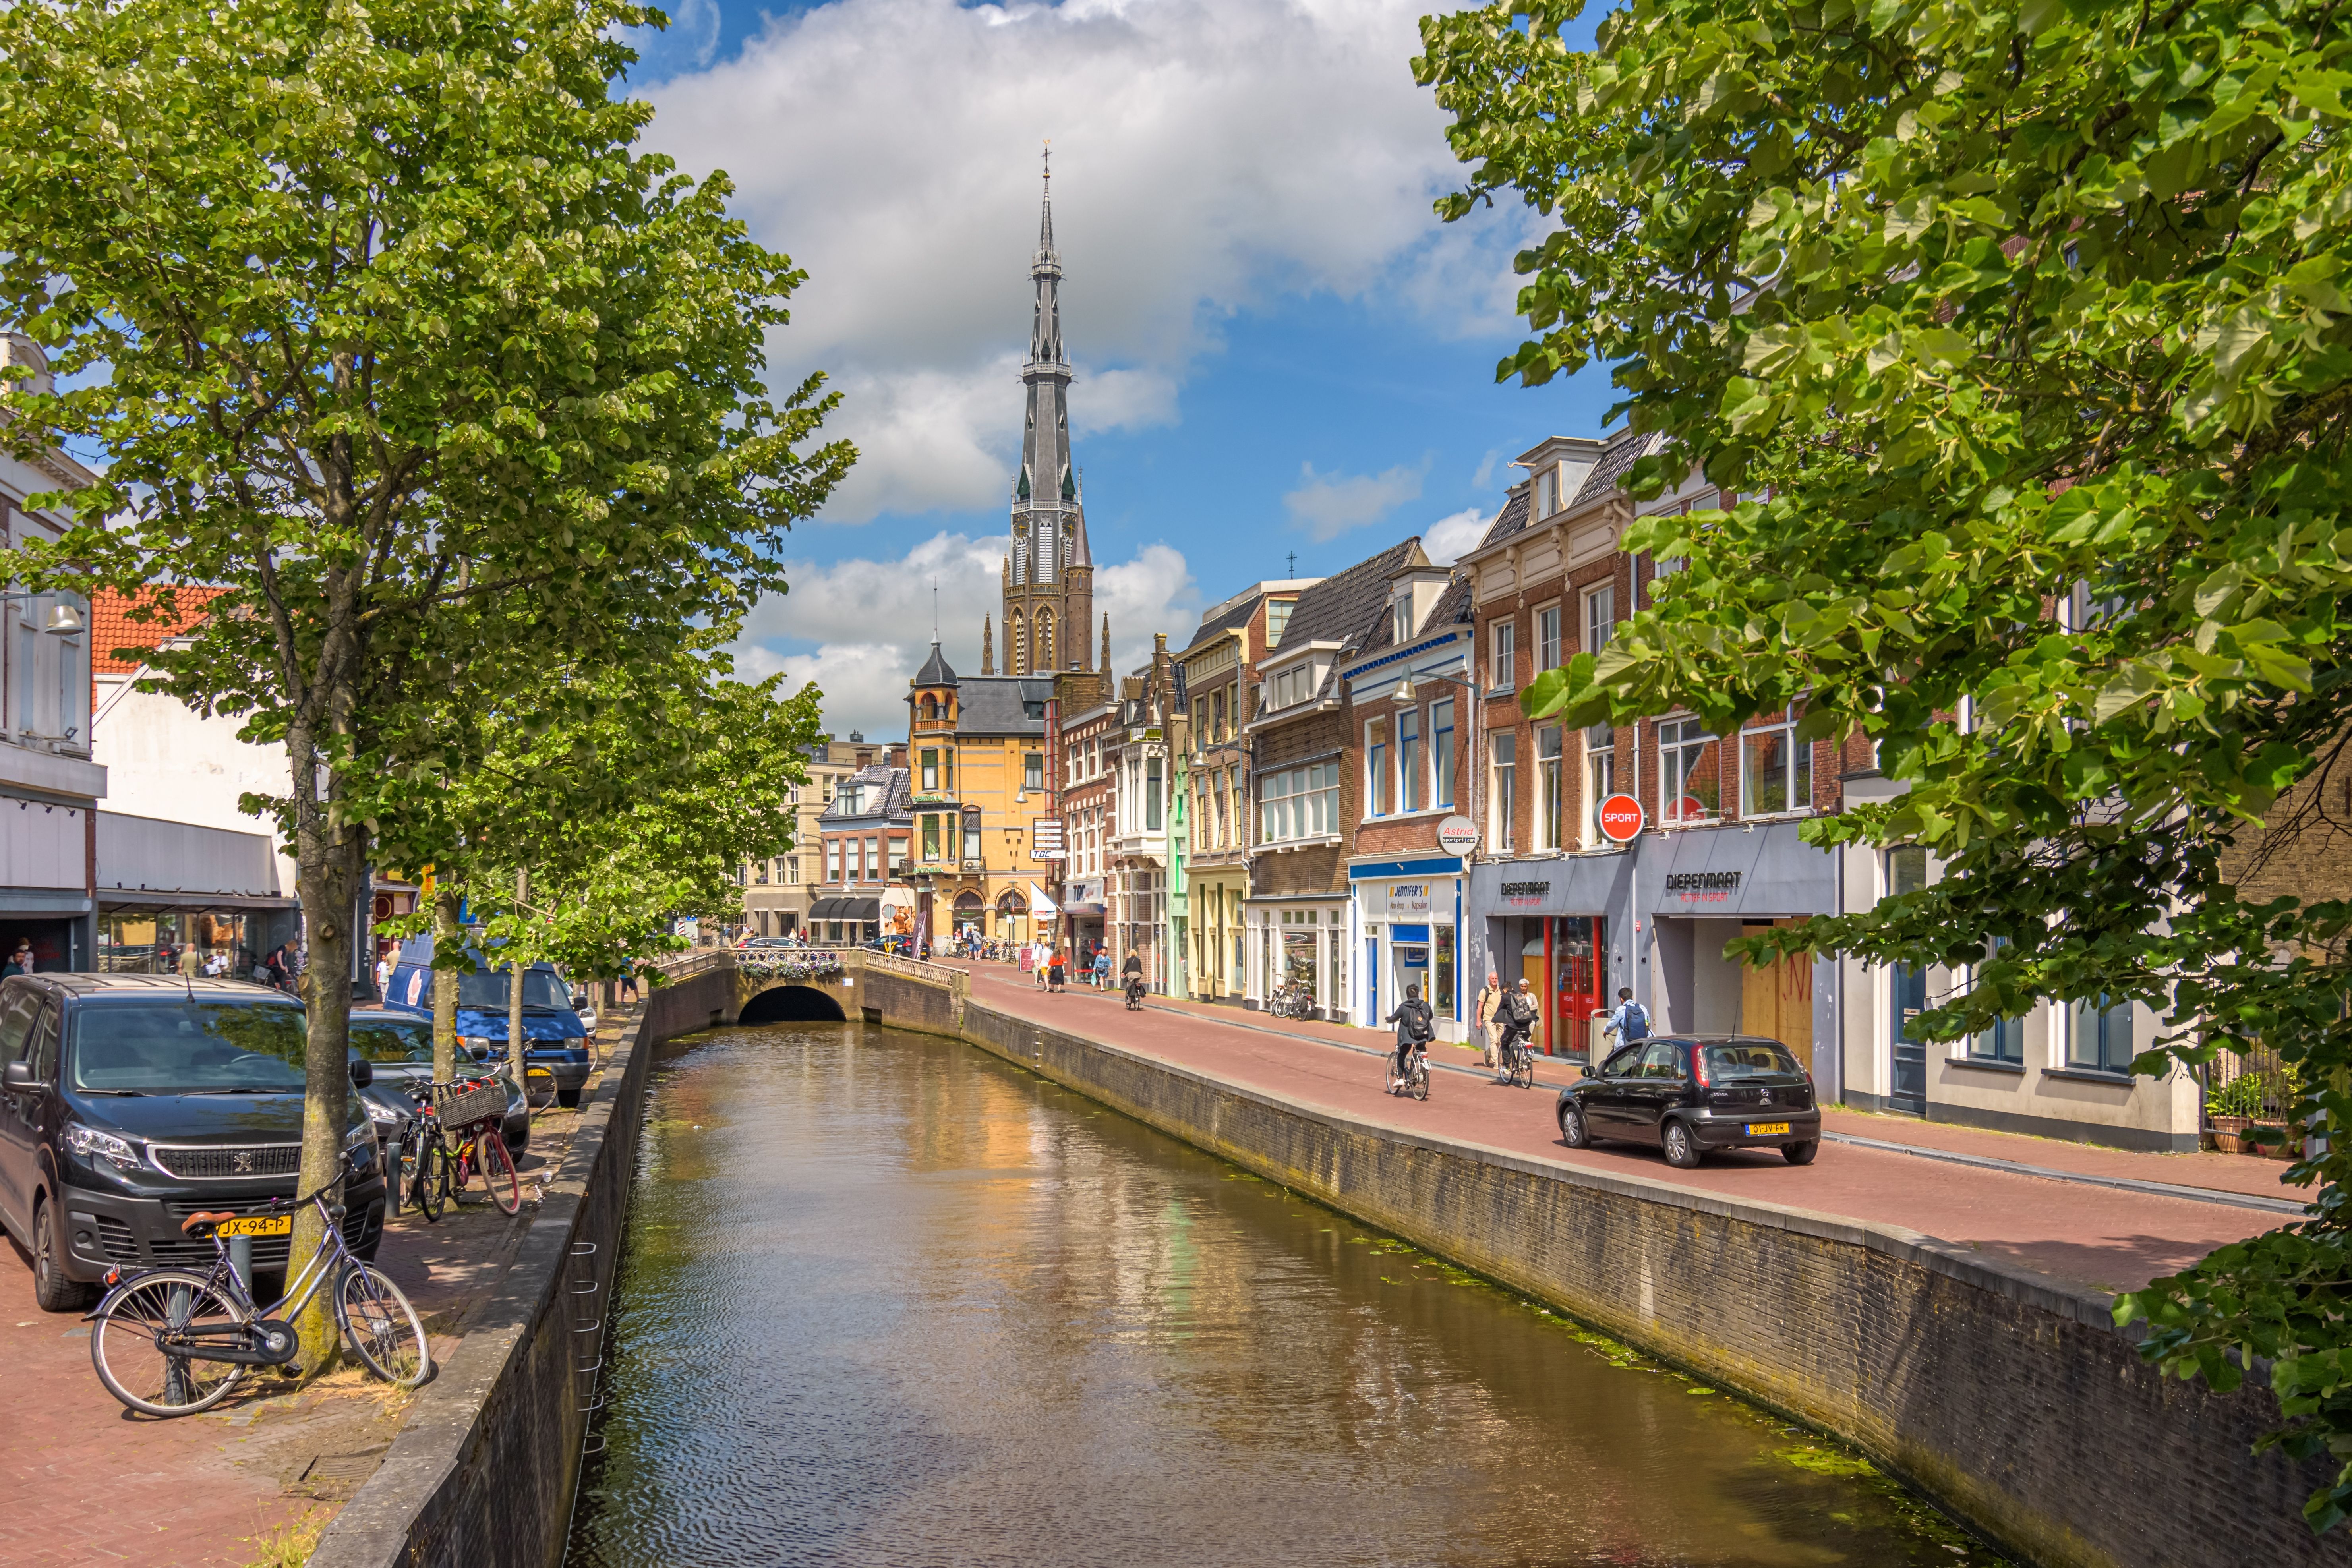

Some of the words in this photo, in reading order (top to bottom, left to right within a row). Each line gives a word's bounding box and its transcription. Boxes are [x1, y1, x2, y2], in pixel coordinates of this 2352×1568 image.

[1604, 813, 1638, 822] SPORT
[1443, 827, 1474, 835] Astrid
[1667, 871, 1743, 889] DIEPENMAAT
[1395, 885, 1422, 897] JENNIFER'S
[1501, 881, 1551, 895] DIEPENMAAT
[1681, 893, 1700, 902] ACTIEF
[1702, 893, 1707, 902] IN
[1709, 893, 1728, 902] SPORT
[1412, 900, 1427, 911] Kapsalon
